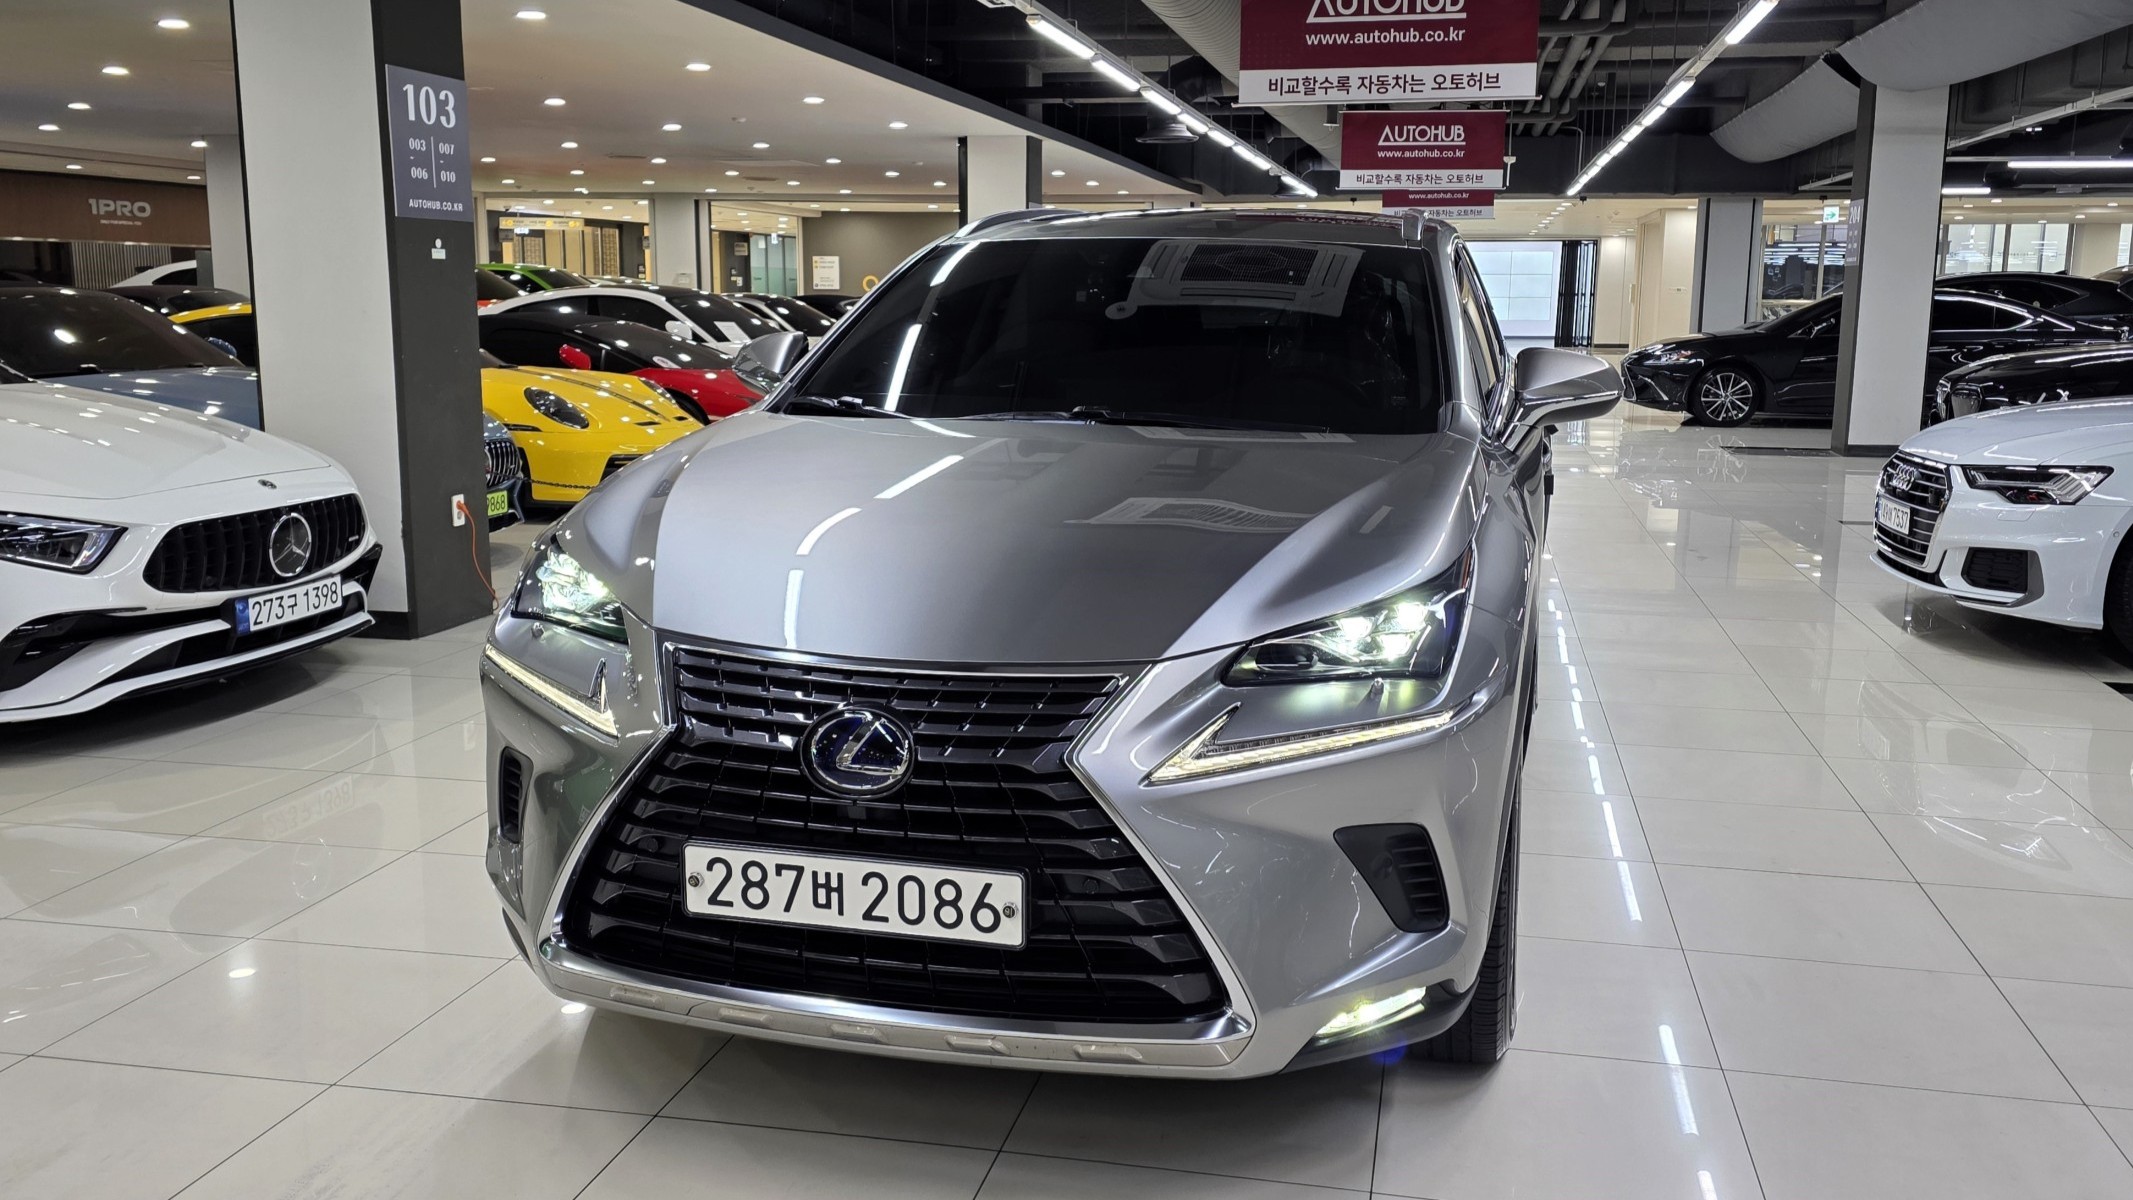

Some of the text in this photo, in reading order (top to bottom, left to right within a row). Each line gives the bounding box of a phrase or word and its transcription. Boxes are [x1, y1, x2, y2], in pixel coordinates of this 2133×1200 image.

[1306, 26, 1466, 46] www.autohub.co.kr
[1268, 71, 1502, 96] 비교할수록 자동차는 오토허브
[403, 83, 456, 128] 103
[1378, 125, 1466, 146] AUTOHUB
[409, 137, 426, 151] 003
[439, 142, 455, 155] 007
[1377, 149, 1466, 158] www.autohub.co.kr
[411, 167, 428, 180] 006
[440, 170, 456, 183] 010
[1356, 173, 1484, 185] 비교할수록 자동차는 오토허브
[1408, 192, 1470, 200] www.autohub.co.kr
[88, 198, 151, 218] 1PRO
[409, 199, 463, 212] AUTOHUB.CO.KR
[1849, 205, 1860, 224] 204
[252, 581, 339, 627] 273구 1398
[706, 856, 1001, 934] 287버 2086
